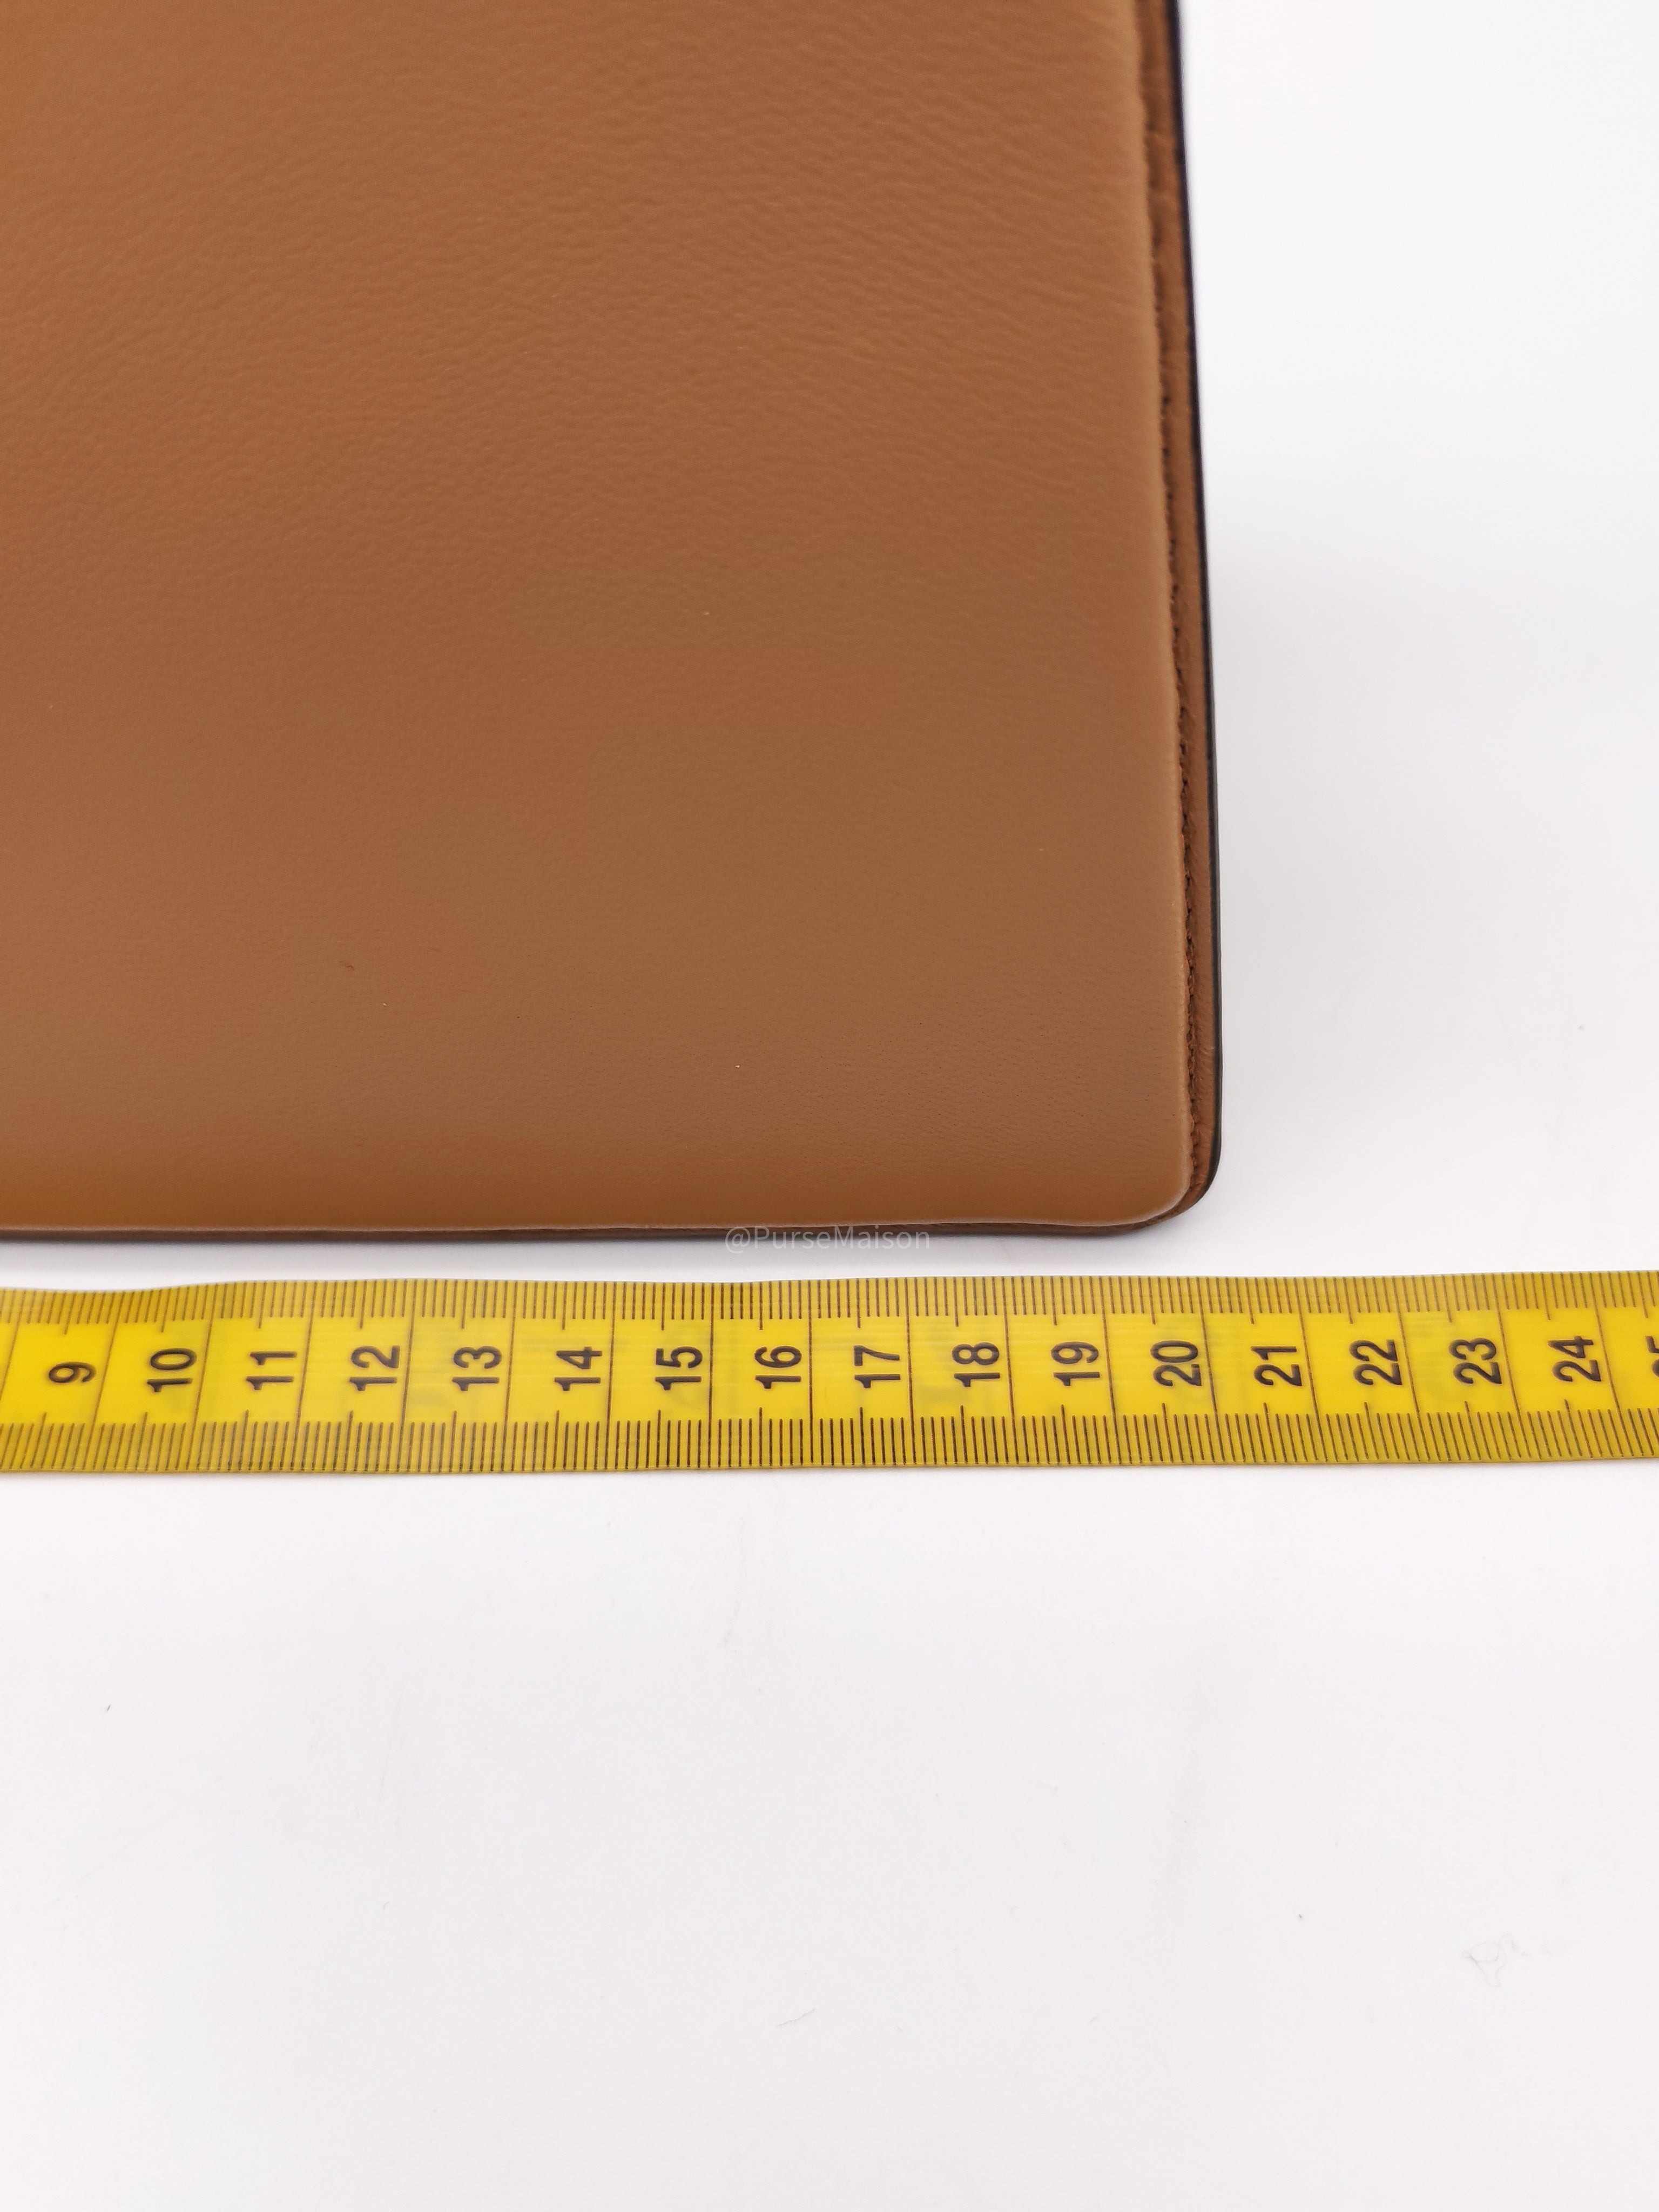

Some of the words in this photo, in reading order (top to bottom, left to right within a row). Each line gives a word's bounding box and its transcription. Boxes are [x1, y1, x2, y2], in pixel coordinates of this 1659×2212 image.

[48, 1362, 95, 1384] 9
[146, 1348, 197, 1393] 10
[246, 1352, 295, 1391] 11
[349, 1346, 399, 1392] 12
[451, 1347, 501, 1392] 13
[554, 1347, 602, 1392] 14
[655, 1346, 703, 1391] 15
[754, 1346, 802, 1390] 16
[853, 1345, 901, 1389] 17
[952, 1343, 1001, 1388] 18
[1051, 1342, 1101, 1386] 19
[1151, 1340, 1202, 1387] 20
[1252, 1346, 1303, 1387] 21
[1350, 1340, 1402, 1386] 22
[1450, 1338, 1502, 1385] 23
[1550, 1336, 1602, 1382] 24
